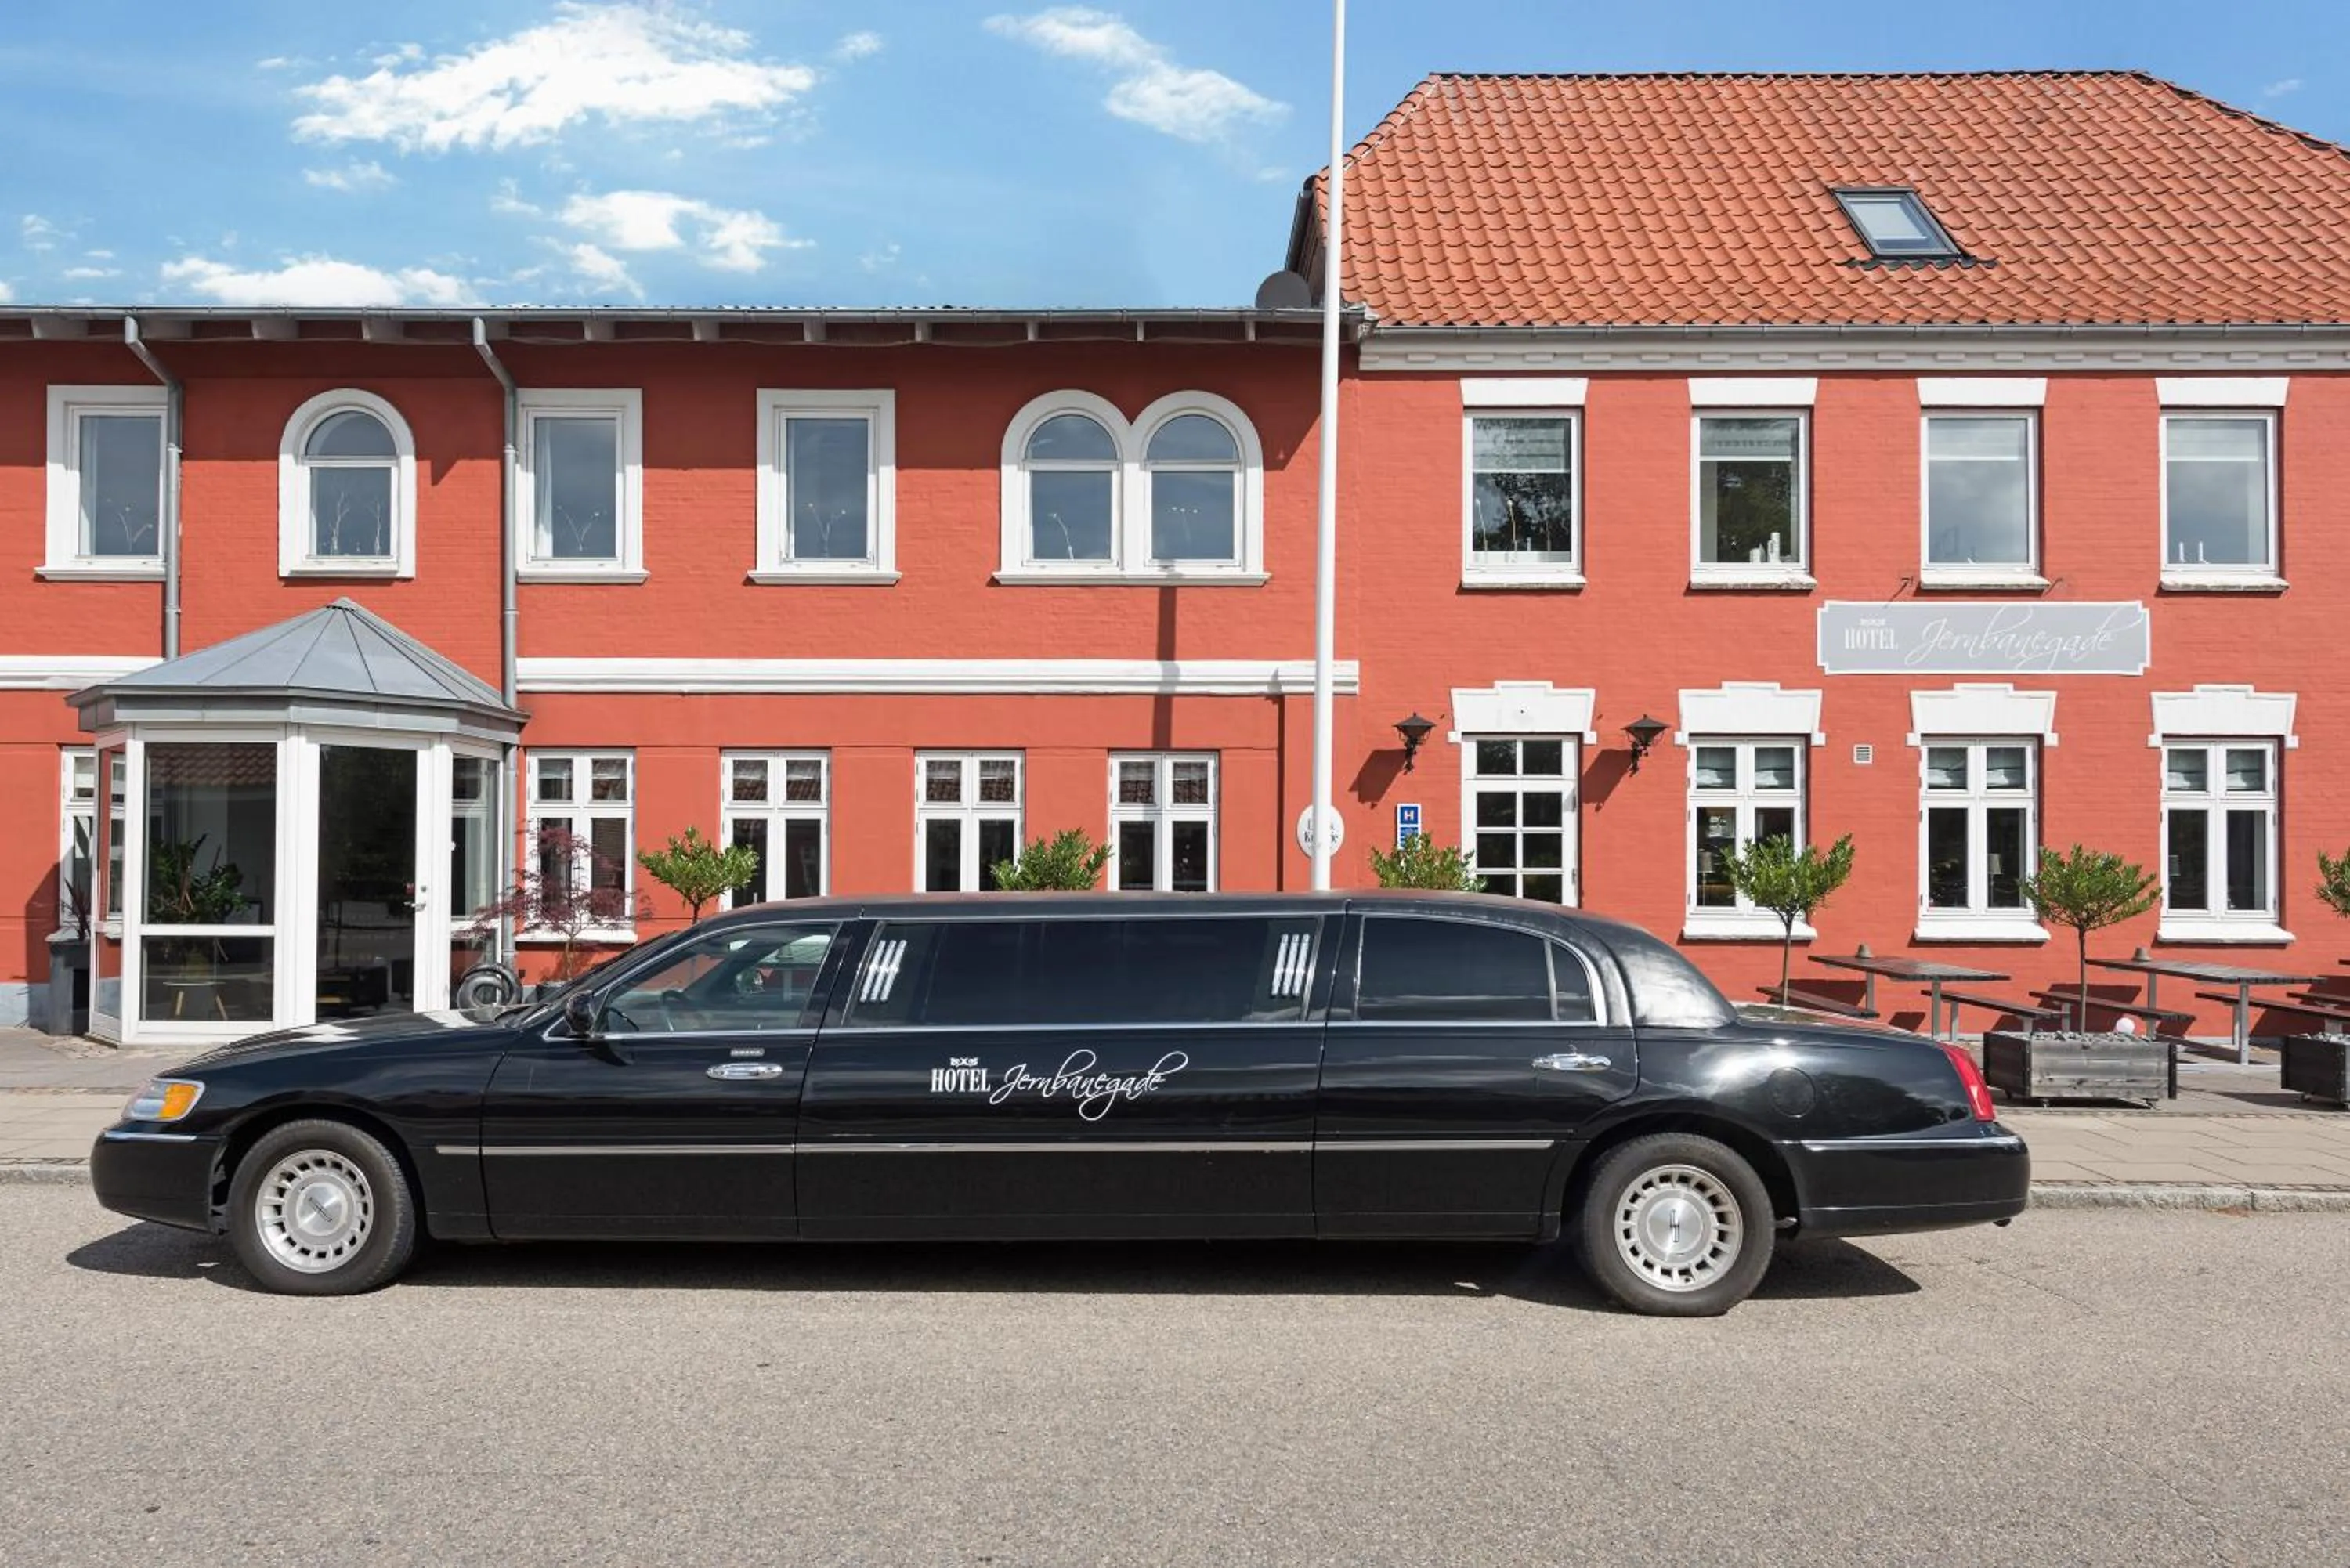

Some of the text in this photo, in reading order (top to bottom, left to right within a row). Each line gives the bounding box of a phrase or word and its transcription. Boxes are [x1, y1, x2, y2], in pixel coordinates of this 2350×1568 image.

[1844, 605, 2144, 670] HOTEL Jernbanegade
[1404, 809, 1415, 821] H
[930, 1049, 1188, 1120] HOTEL Jernbanegade
